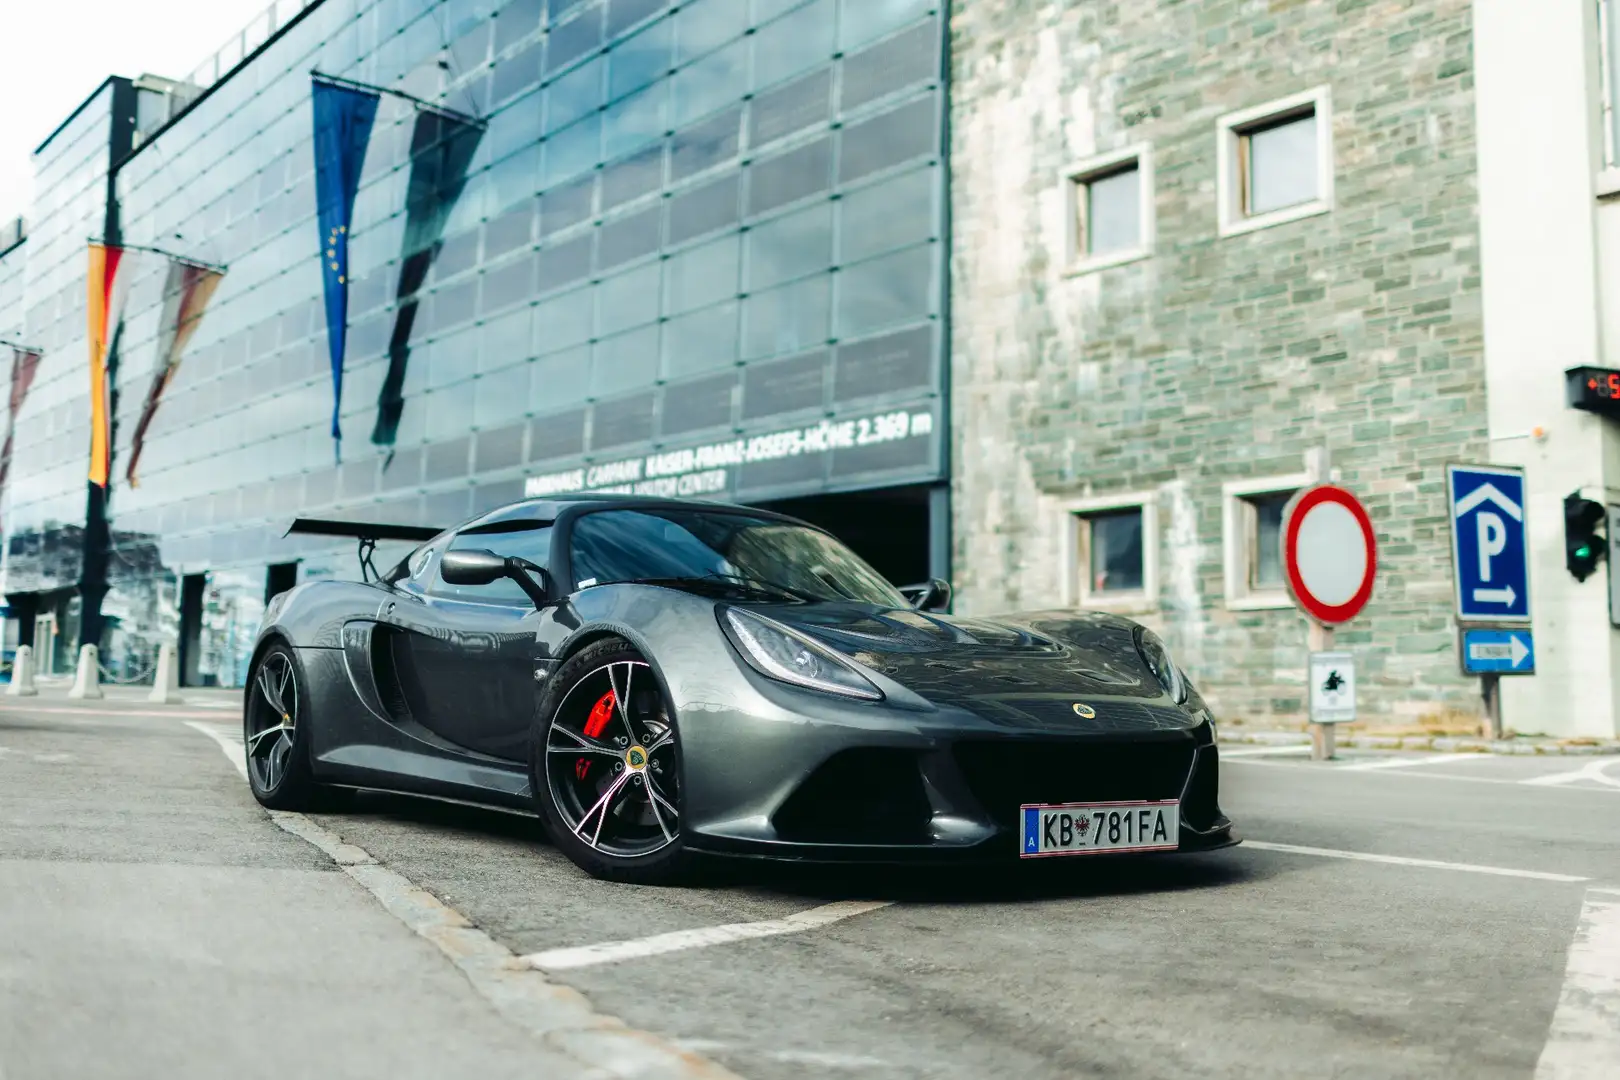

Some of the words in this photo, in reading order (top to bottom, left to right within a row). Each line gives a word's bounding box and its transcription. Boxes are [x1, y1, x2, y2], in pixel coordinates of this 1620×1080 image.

[856, 411, 909, 445] 2.369
[911, 412, 932, 436] m
[677, 469, 727, 496] CENTER
[1476, 511, 1507, 582] P
[1028, 836, 1035, 847] A
